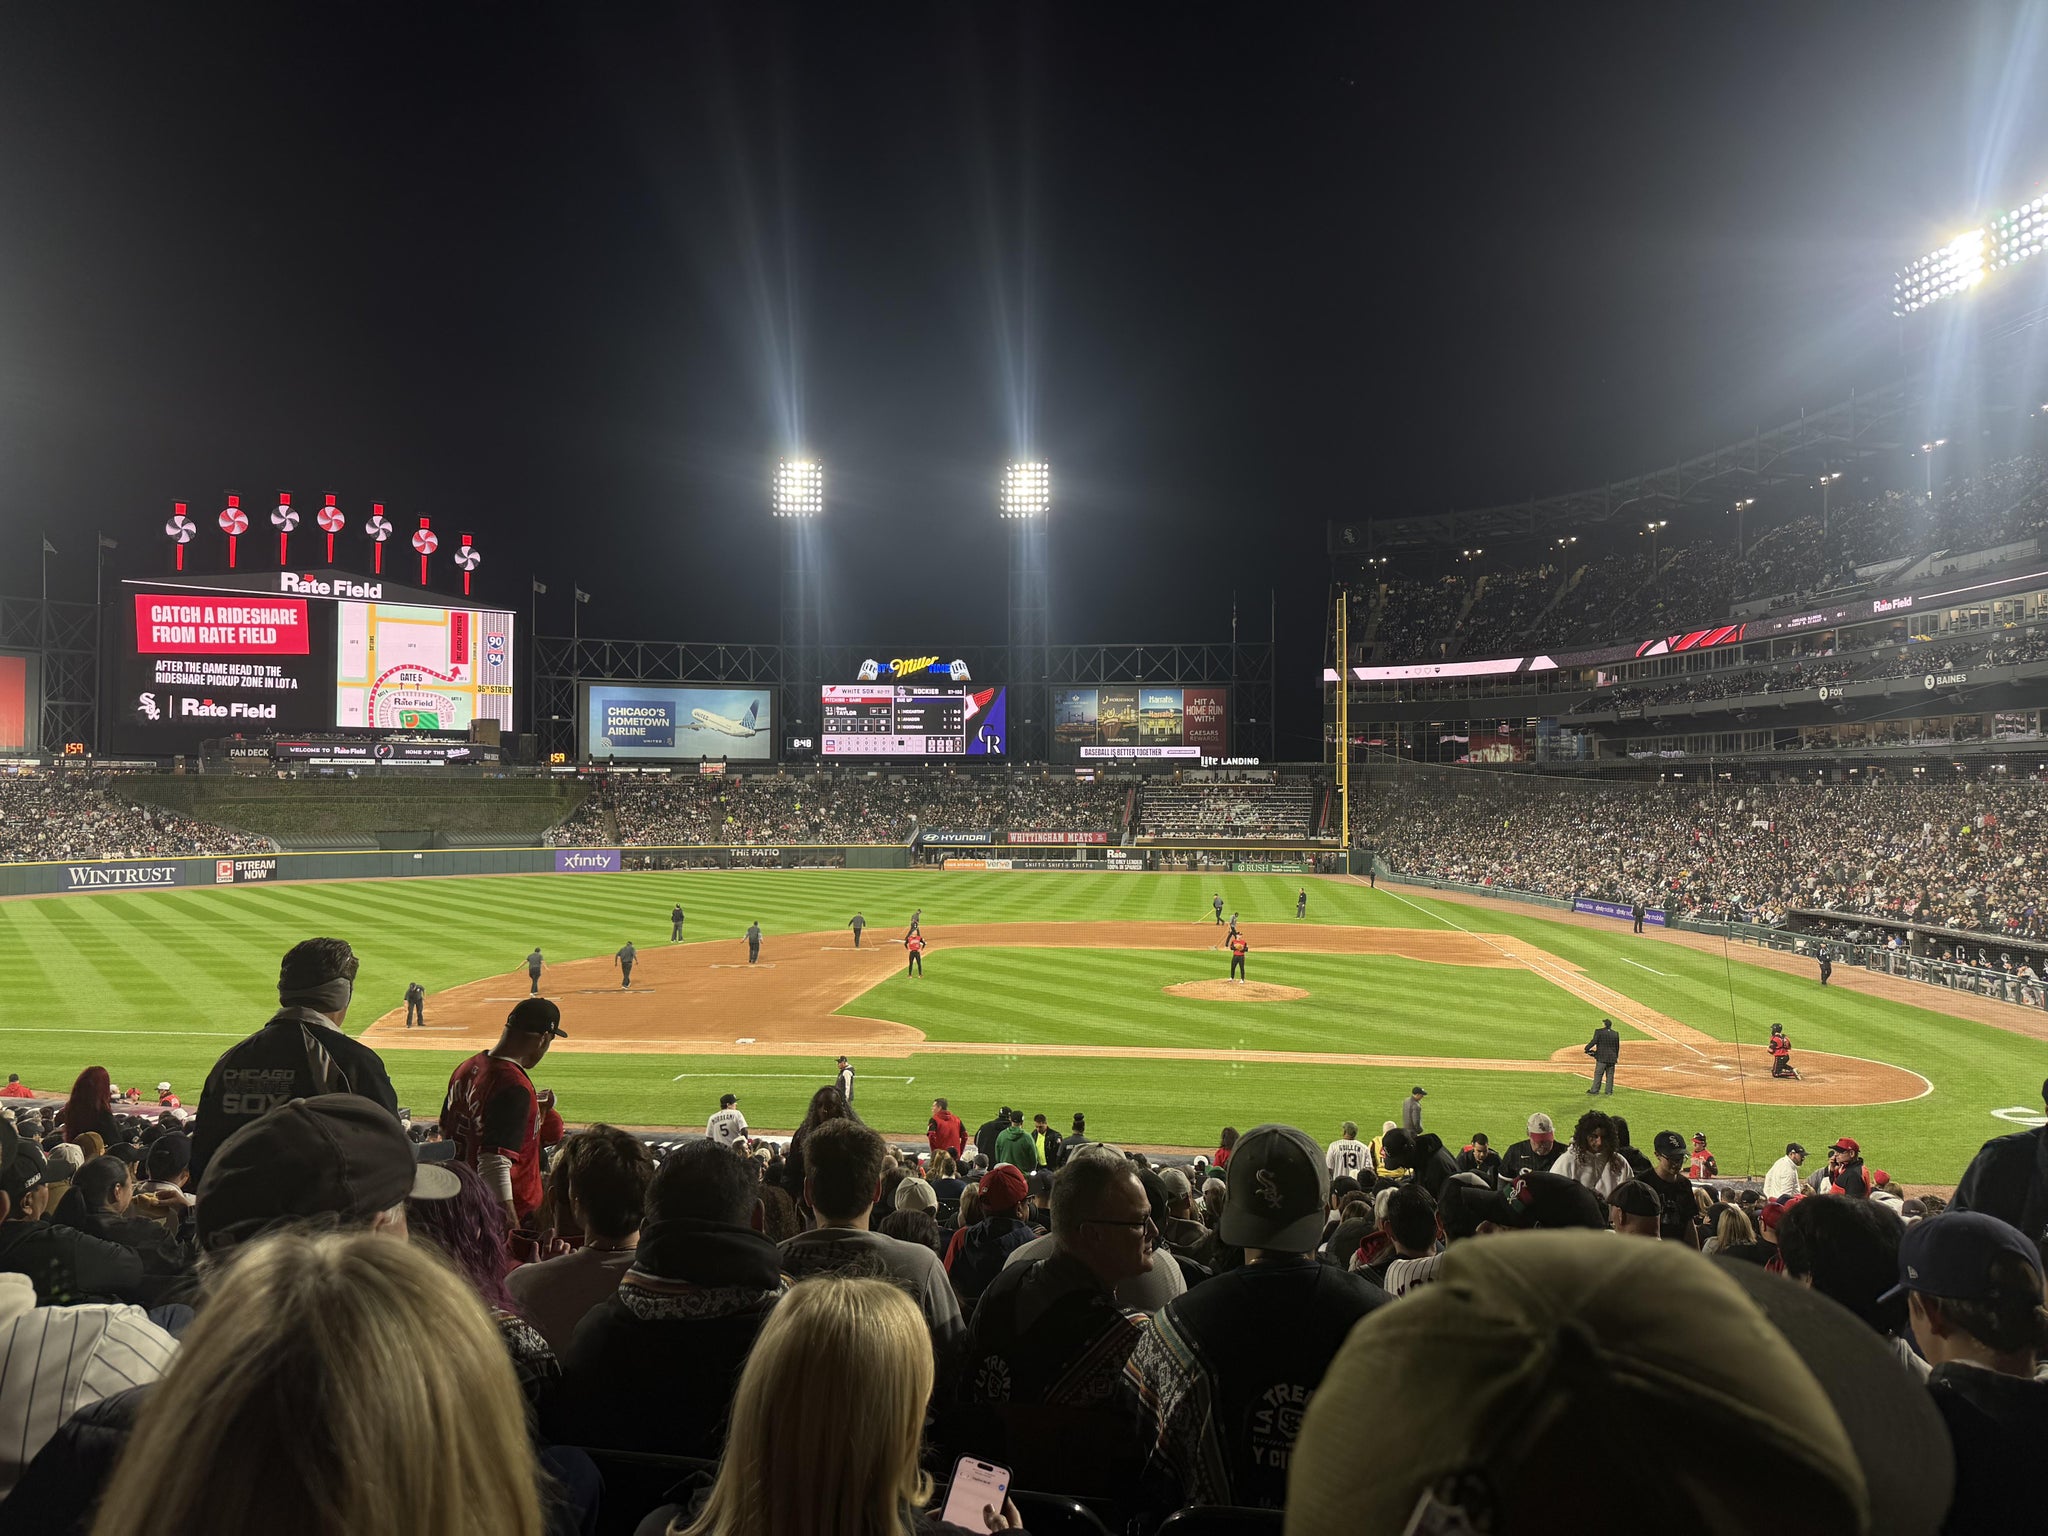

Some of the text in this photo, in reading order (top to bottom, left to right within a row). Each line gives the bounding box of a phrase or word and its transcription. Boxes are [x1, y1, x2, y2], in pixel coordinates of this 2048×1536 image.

[281, 572, 382, 599] Rate Field
[1874, 597, 1912, 612] Rate Field
[152, 606, 298, 625] CATCH A RIDESHARE
[152, 626, 276, 644] FROM RATE FIELD
[489, 637, 502, 646] 90
[489, 655, 501, 663] 94
[156, 660, 282, 677] AFTER THE GAME HEAD TO THE
[890, 656, 940, 678] Miller
[156, 673, 298, 689] RIDESHARE PICKUP ZONE IN LOT A
[400, 673, 416, 681] GATE
[1937, 674, 1967, 685] BAINES
[1830, 688, 1843, 696] FOX
[394, 697, 412, 706] Rate
[182, 698, 228, 716] Rate
[231, 703, 276, 718] Field
[608, 707, 665, 717] CHICAGO'S
[1186, 706, 1223, 715] HOME RUN
[608, 717, 669, 727] HOMETOWN
[608, 727, 646, 736] AIRLINE
[65, 743, 83, 754] 1:59
[794, 739, 811, 748] 8:48
[230, 749, 268, 757] FAN DECK
[1085, 748, 1110, 756] BASEBALL
[1111, 748, 1116, 756] IS
[1117, 748, 1135, 756] BETTER
[1136, 748, 1162, 756] TOGETHER
[551, 753, 565, 762] 1:59
[1201, 756, 1217, 767] Lite
[1010, 833, 1064, 842] WHITTINGHAM
[1067, 833, 1093, 842] MEATS
[1107, 850, 1126, 858] Rate
[235, 860, 275, 871] STREAM
[564, 854, 611, 868] xfinity
[1246, 864, 1268, 872] RUSH
[68, 867, 176, 885] WINTRUST
[244, 869, 266, 879] NOW
[223, 1069, 295, 1079] CHICAGO
[720, 1123, 729, 1137] 5
[1343, 1153, 1357, 1168] 13
[1253, 1410, 1274, 1436] LA
[1253, 1445, 1265, 1465] Y
